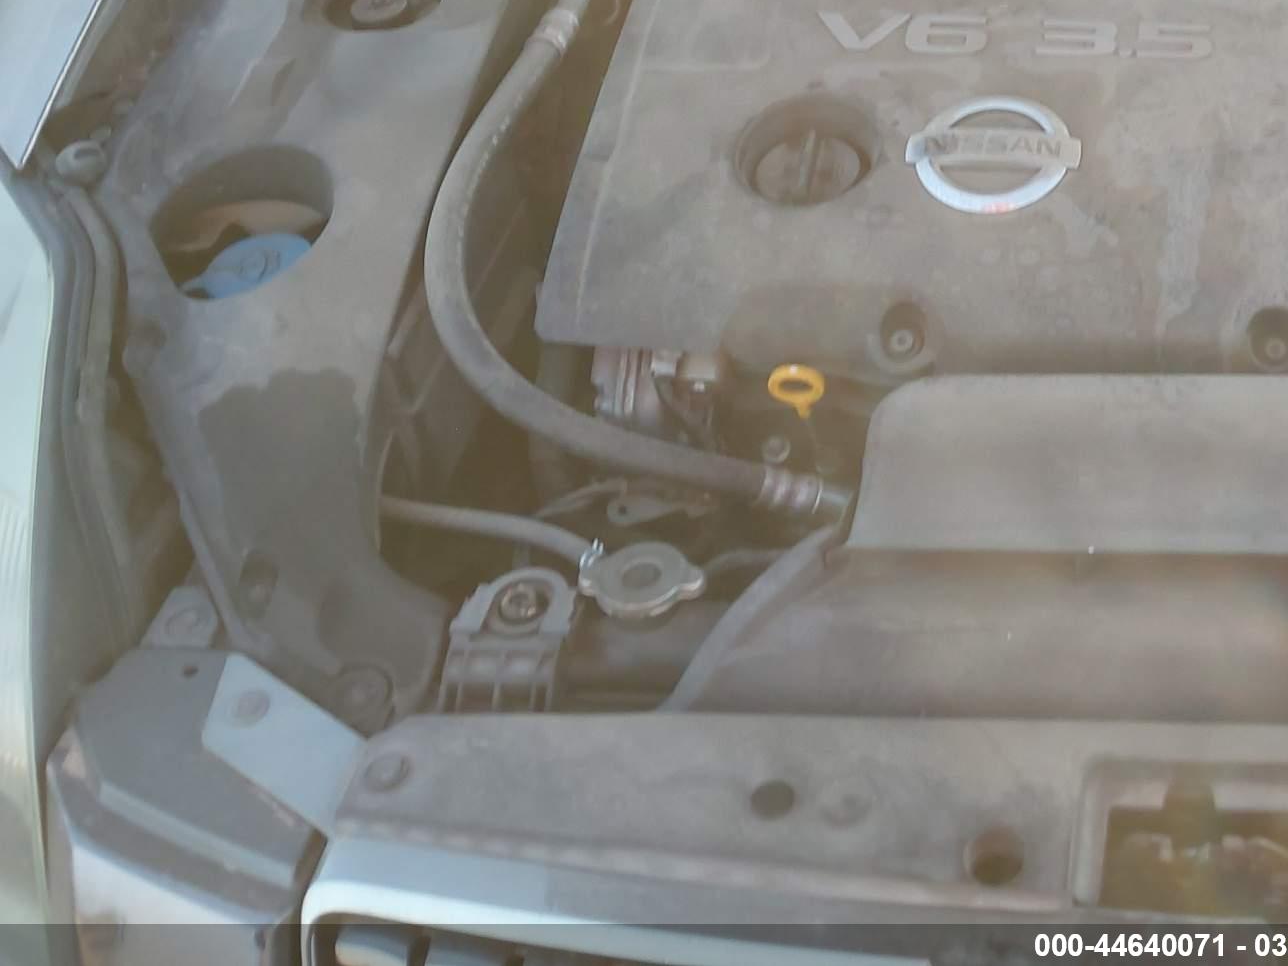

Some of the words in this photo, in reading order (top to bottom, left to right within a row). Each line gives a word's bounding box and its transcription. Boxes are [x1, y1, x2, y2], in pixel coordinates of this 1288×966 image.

[817, 11, 989, 56] V6
[1035, 18, 1212, 59] 3.5
[923, 133, 1062, 158] NISSAN
